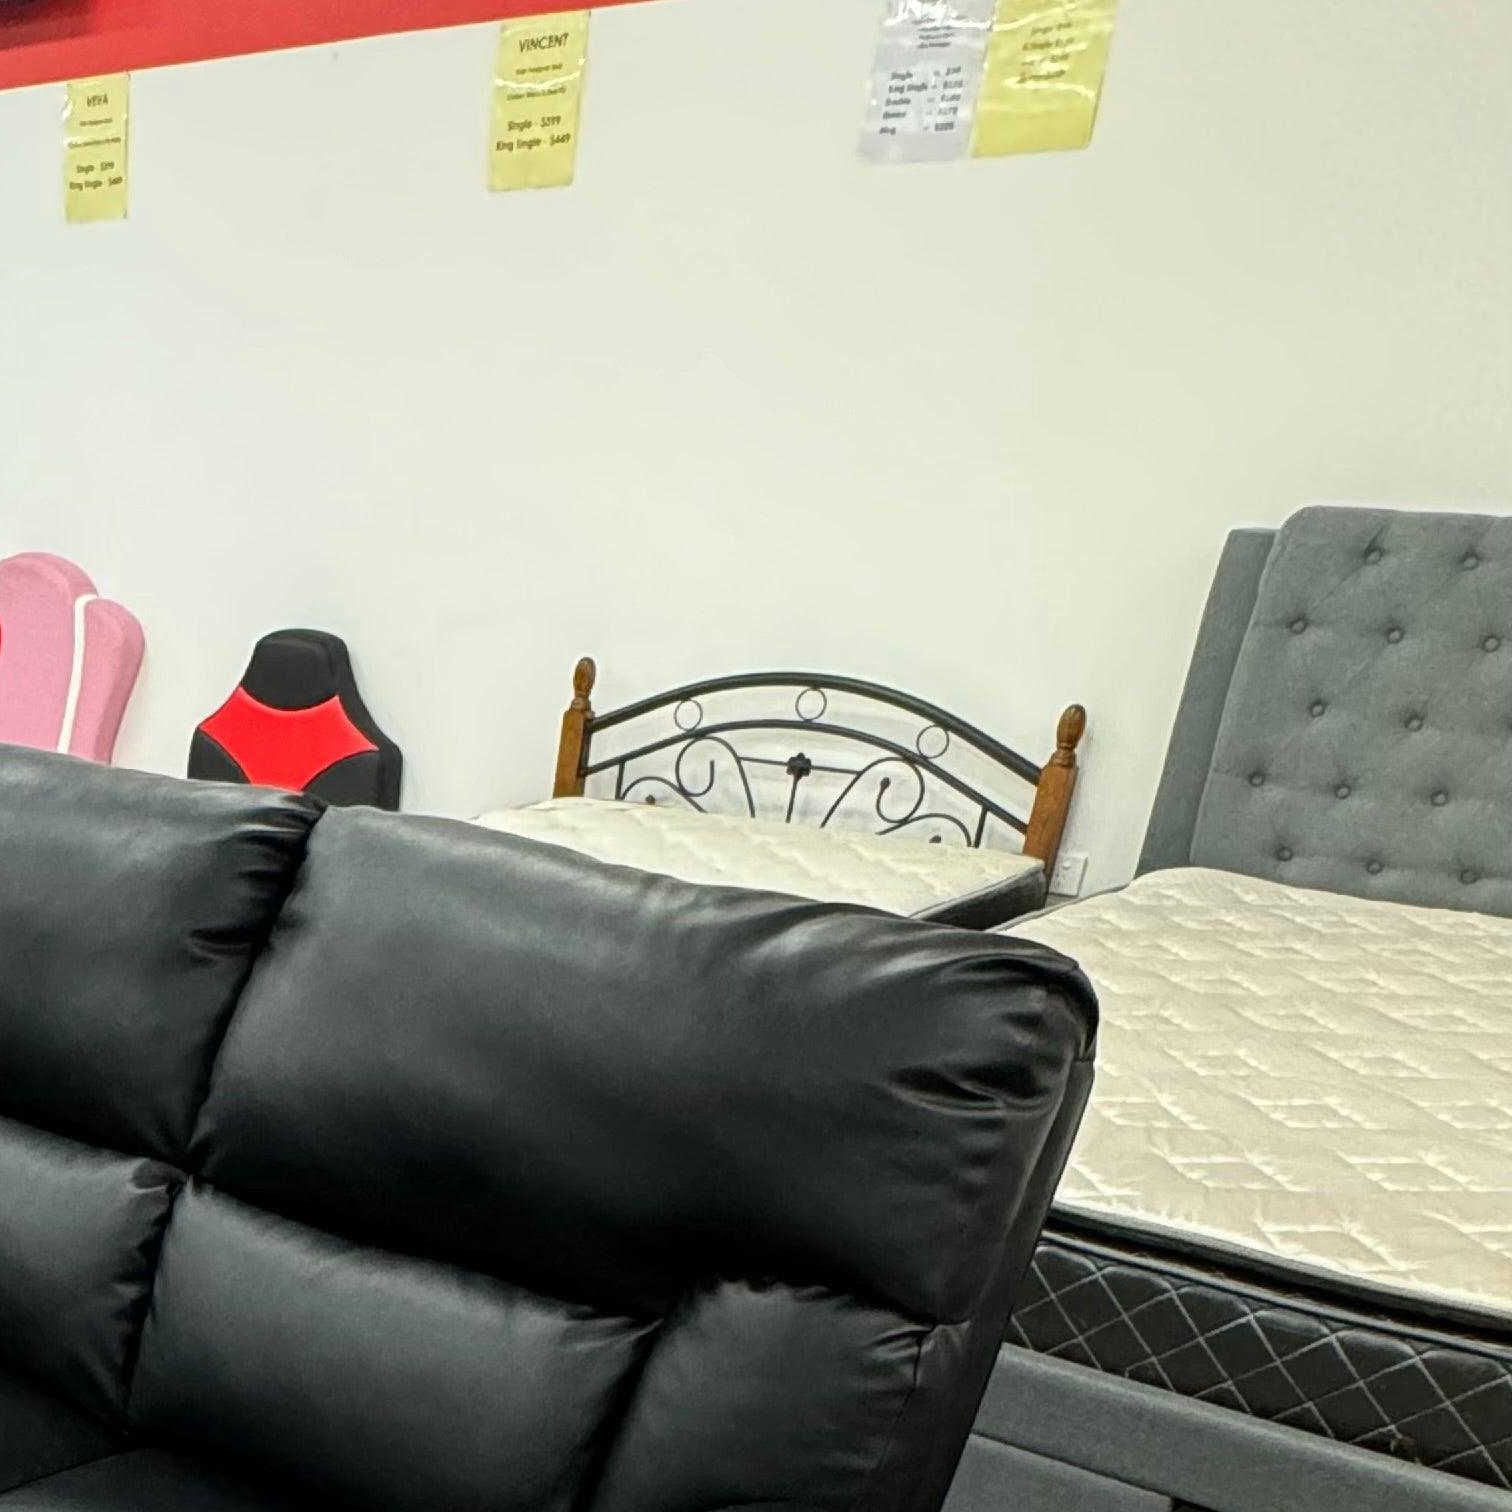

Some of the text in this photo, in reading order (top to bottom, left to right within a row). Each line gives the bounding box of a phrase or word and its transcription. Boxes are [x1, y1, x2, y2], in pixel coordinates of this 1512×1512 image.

[518, 32, 568, 52] VINCENT
[507, 119, 532, 131] Single
[496, 140, 513, 151] King
[516, 138, 541, 149] Single
[76, 164, 94, 175] Single
[69, 181, 83, 191] King
